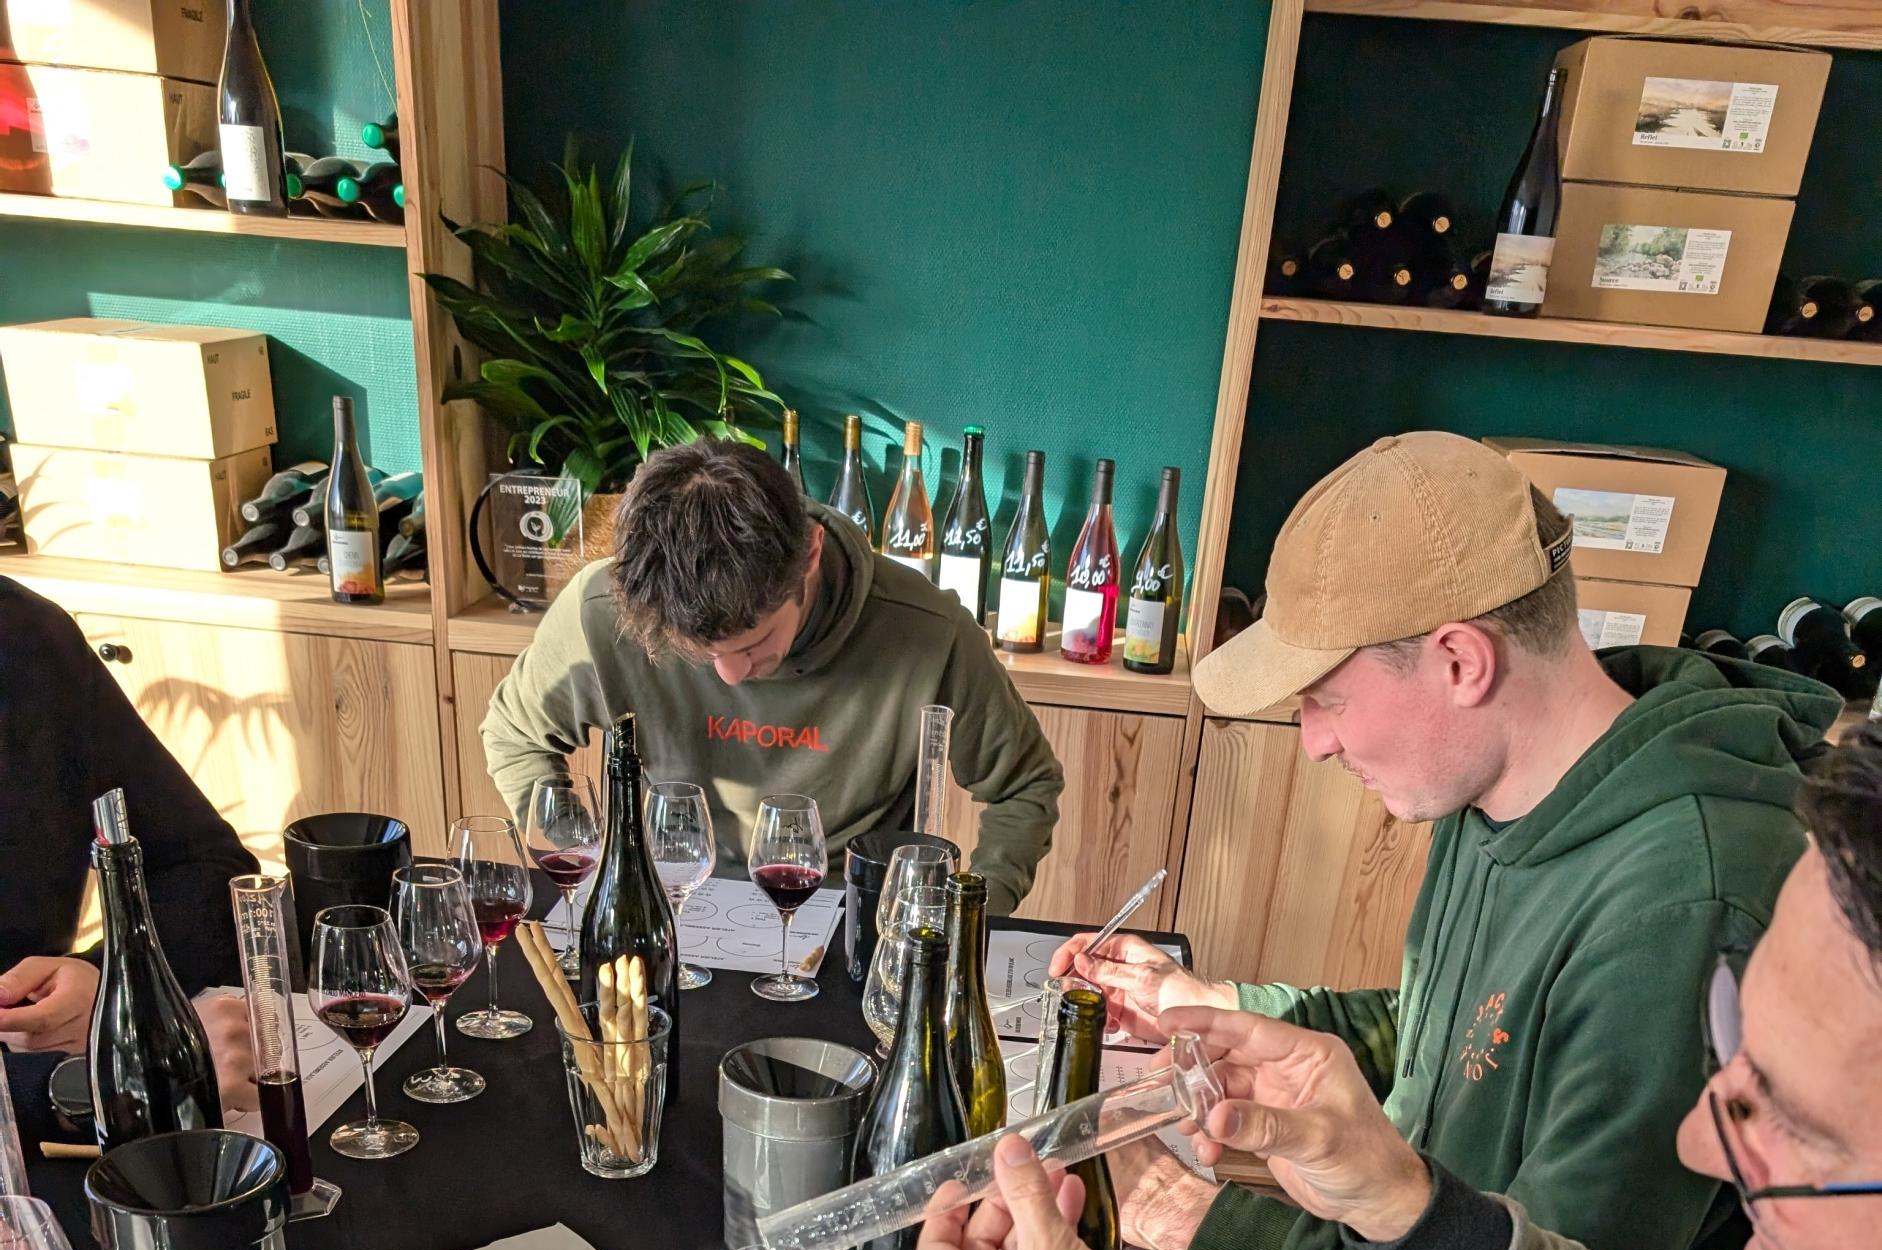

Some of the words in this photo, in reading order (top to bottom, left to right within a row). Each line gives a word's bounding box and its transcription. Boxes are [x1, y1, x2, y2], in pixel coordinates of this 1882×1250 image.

[231, 388, 252, 401] FRAGILE
[499, 484, 570, 498] ENTREPRENEUR
[524, 495, 546, 505] 2023
[707, 714, 830, 752] KAPORAL
